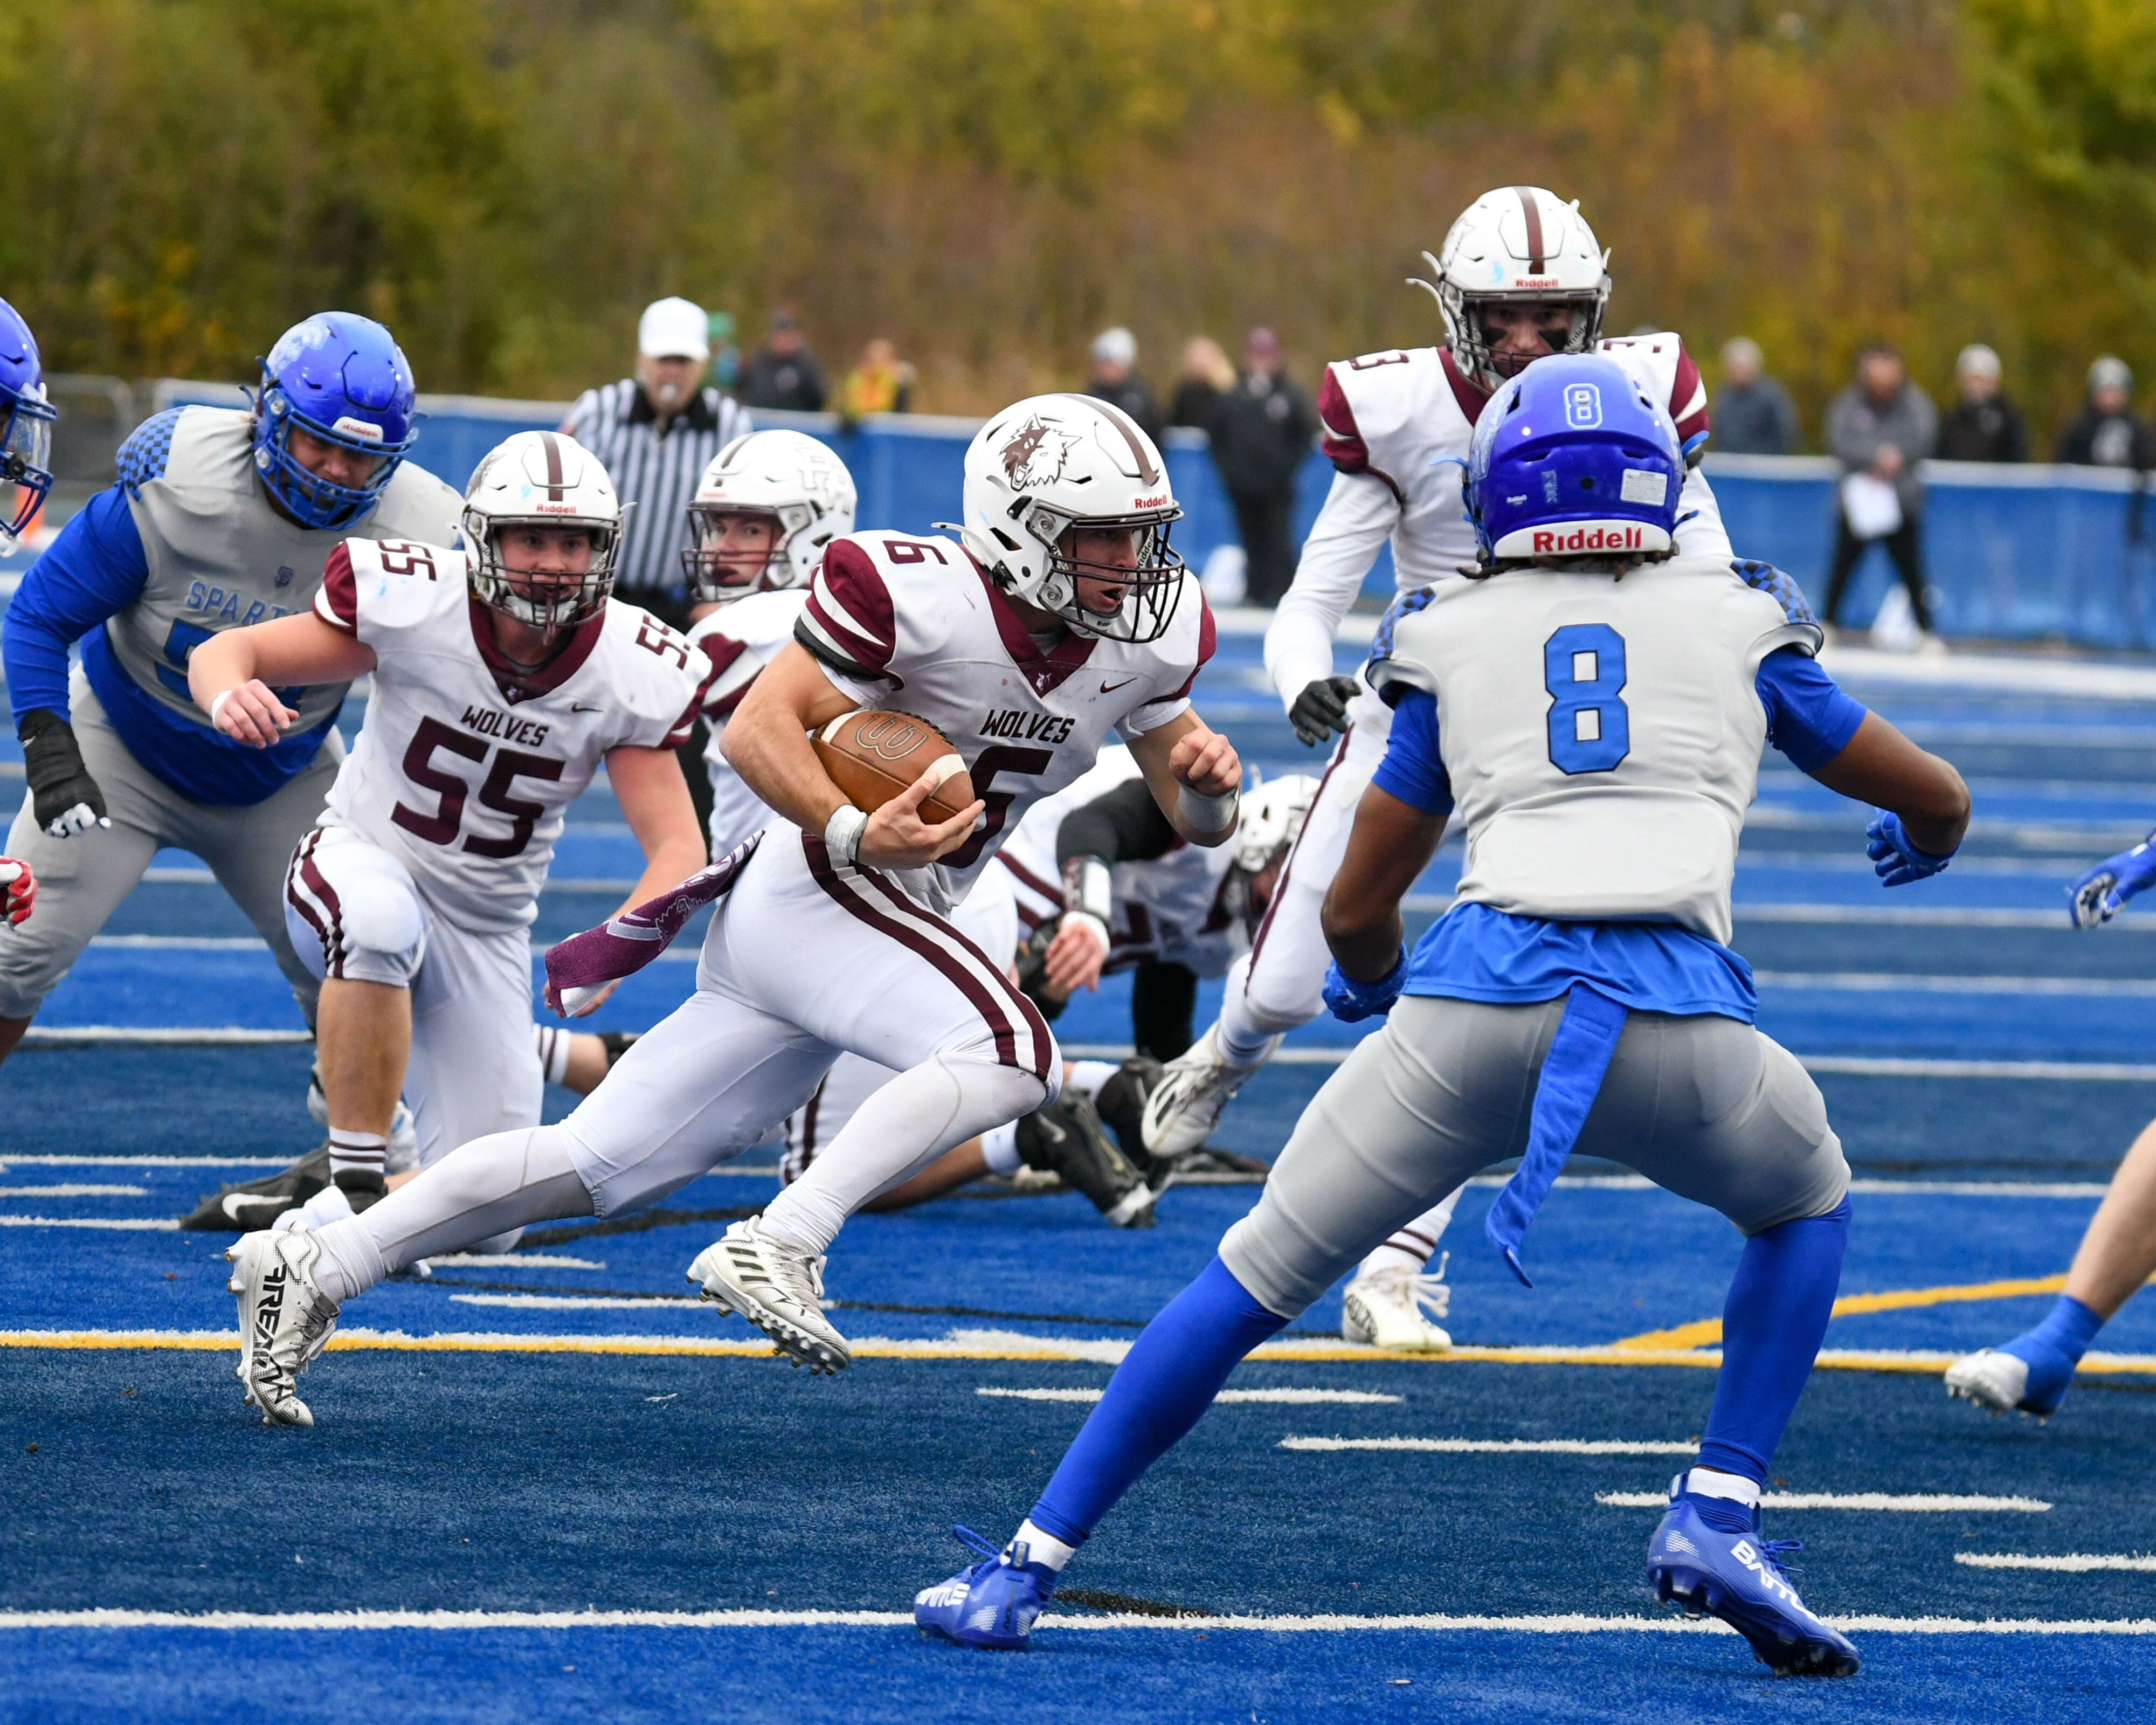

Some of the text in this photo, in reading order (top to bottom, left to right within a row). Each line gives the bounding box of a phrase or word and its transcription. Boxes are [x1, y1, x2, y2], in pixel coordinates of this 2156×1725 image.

[1516, 279, 1558, 287] Riddell
[1564, 383, 1603, 429] 8
[536, 504, 576, 513] Riddell
[1135, 494, 1167, 508] Riddell
[882, 540, 949, 565] 6
[1533, 527, 1642, 552] Riddell
[378, 540, 437, 582] 55
[184, 580, 301, 625] SPART
[1544, 623, 1630, 775] 8
[460, 705, 549, 747] WOLVES
[979, 709, 1075, 744] WOLVES
[390, 714, 566, 859] 55
[1730, 1539, 1825, 1626] BATTL
